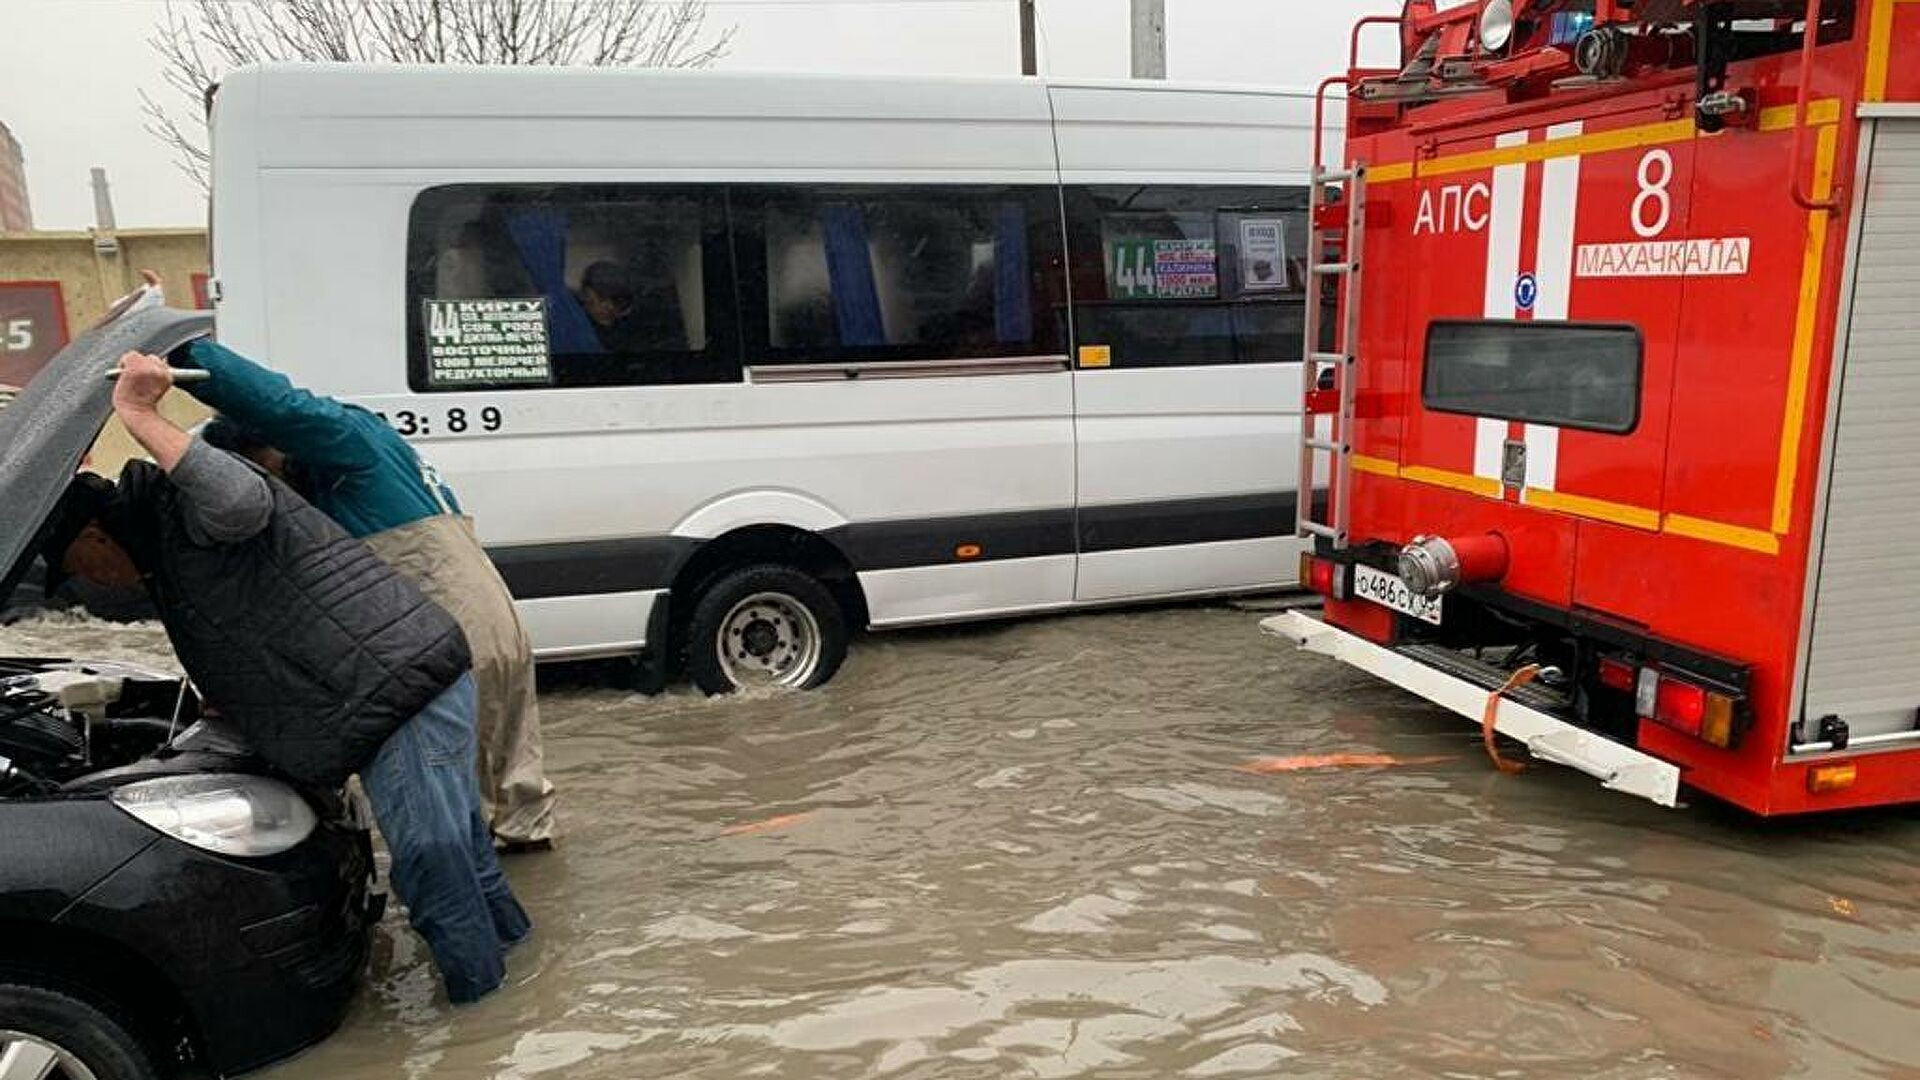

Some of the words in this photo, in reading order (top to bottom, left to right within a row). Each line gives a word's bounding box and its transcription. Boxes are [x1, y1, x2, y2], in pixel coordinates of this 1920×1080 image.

[1412, 182, 1490, 236] АПС
[1630, 148, 1673, 238] 8
[1116, 247, 1155, 297] 44
[1579, 240, 1745, 273] МАХАЧКАЛА
[429, 303, 461, 344] 44
[460, 300, 541, 313] КИРГУ
[432, 344, 546, 356] ВОСТОЧНЫЙ
[434, 367, 549, 380] РЕДУКТОРНЫЙ
